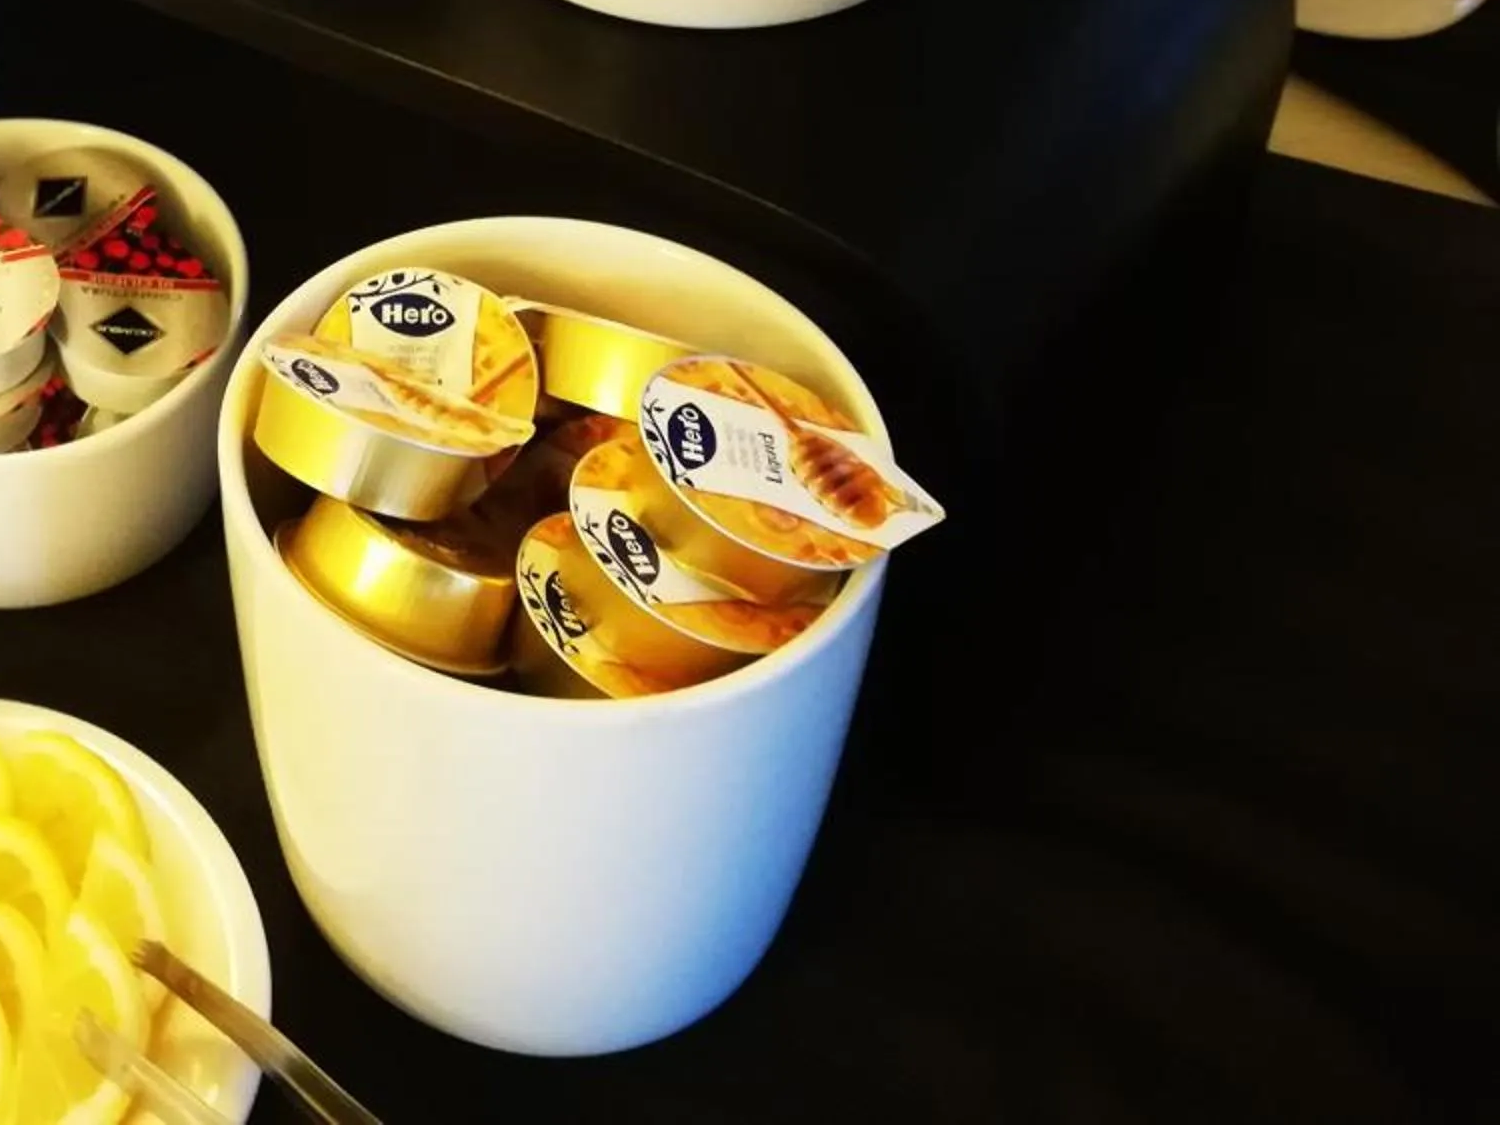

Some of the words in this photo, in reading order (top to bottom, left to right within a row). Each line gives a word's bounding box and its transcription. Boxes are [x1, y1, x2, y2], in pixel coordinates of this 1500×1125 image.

[381, 302, 448, 325] Hero
[677, 407, 706, 463] Hero
[611, 514, 656, 575] Hero
